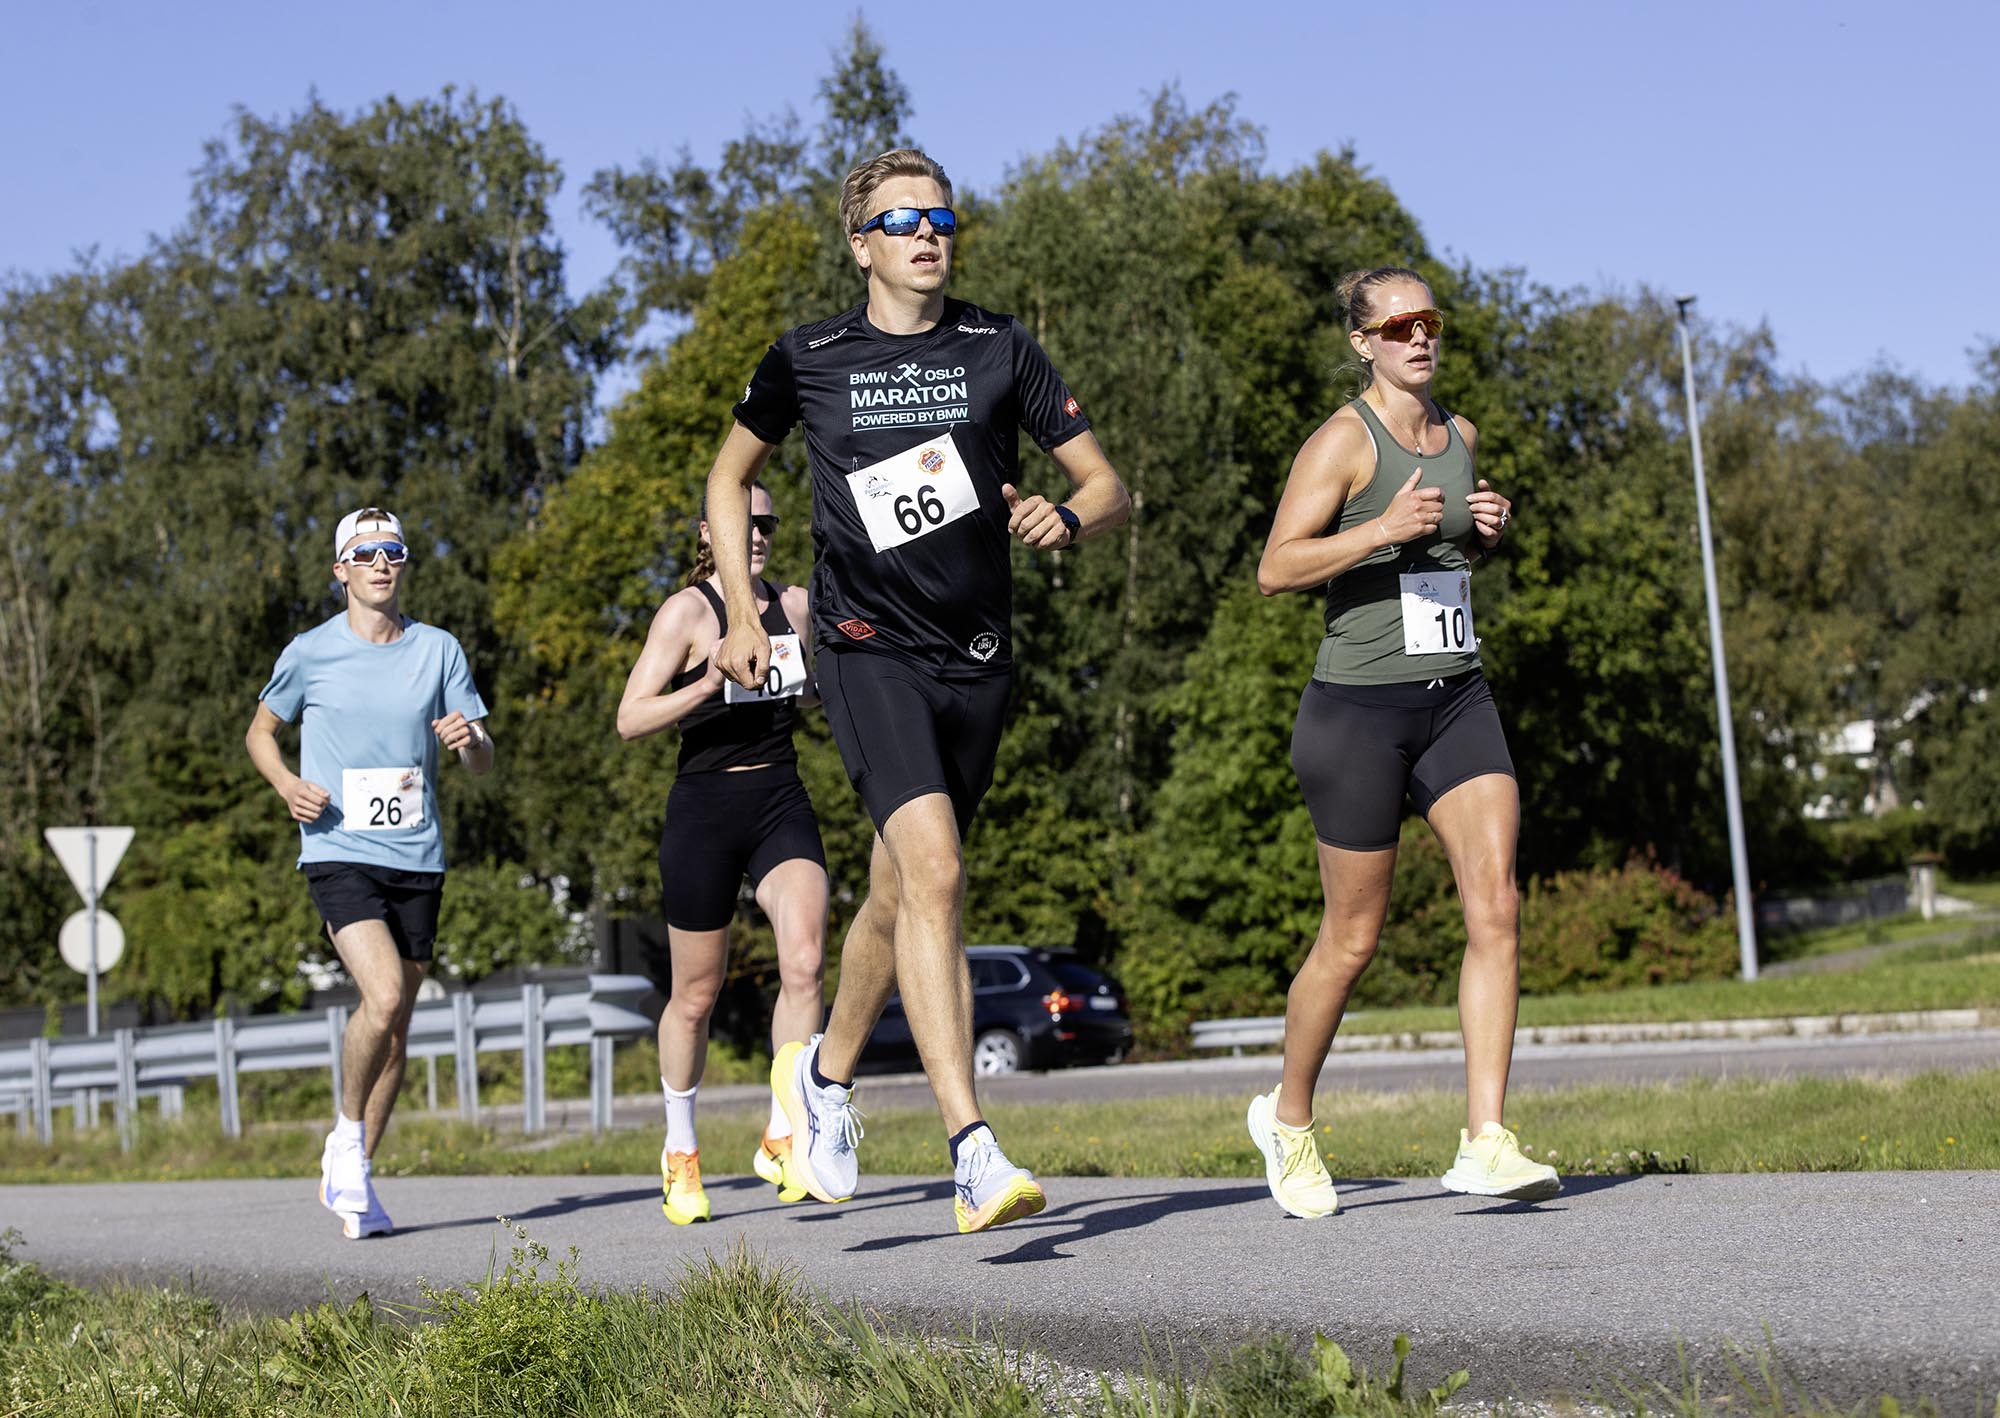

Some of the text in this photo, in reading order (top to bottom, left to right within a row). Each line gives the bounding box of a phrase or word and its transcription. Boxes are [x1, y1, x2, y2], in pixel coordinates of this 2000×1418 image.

[849, 366, 966, 385] BMW OSLO
[850, 381, 968, 409] MARATON
[852, 407, 969, 428] POWERED BY BMW
[893, 484, 945, 536] 66
[1434, 607, 1465, 649] 10
[369, 796, 402, 826] 26
